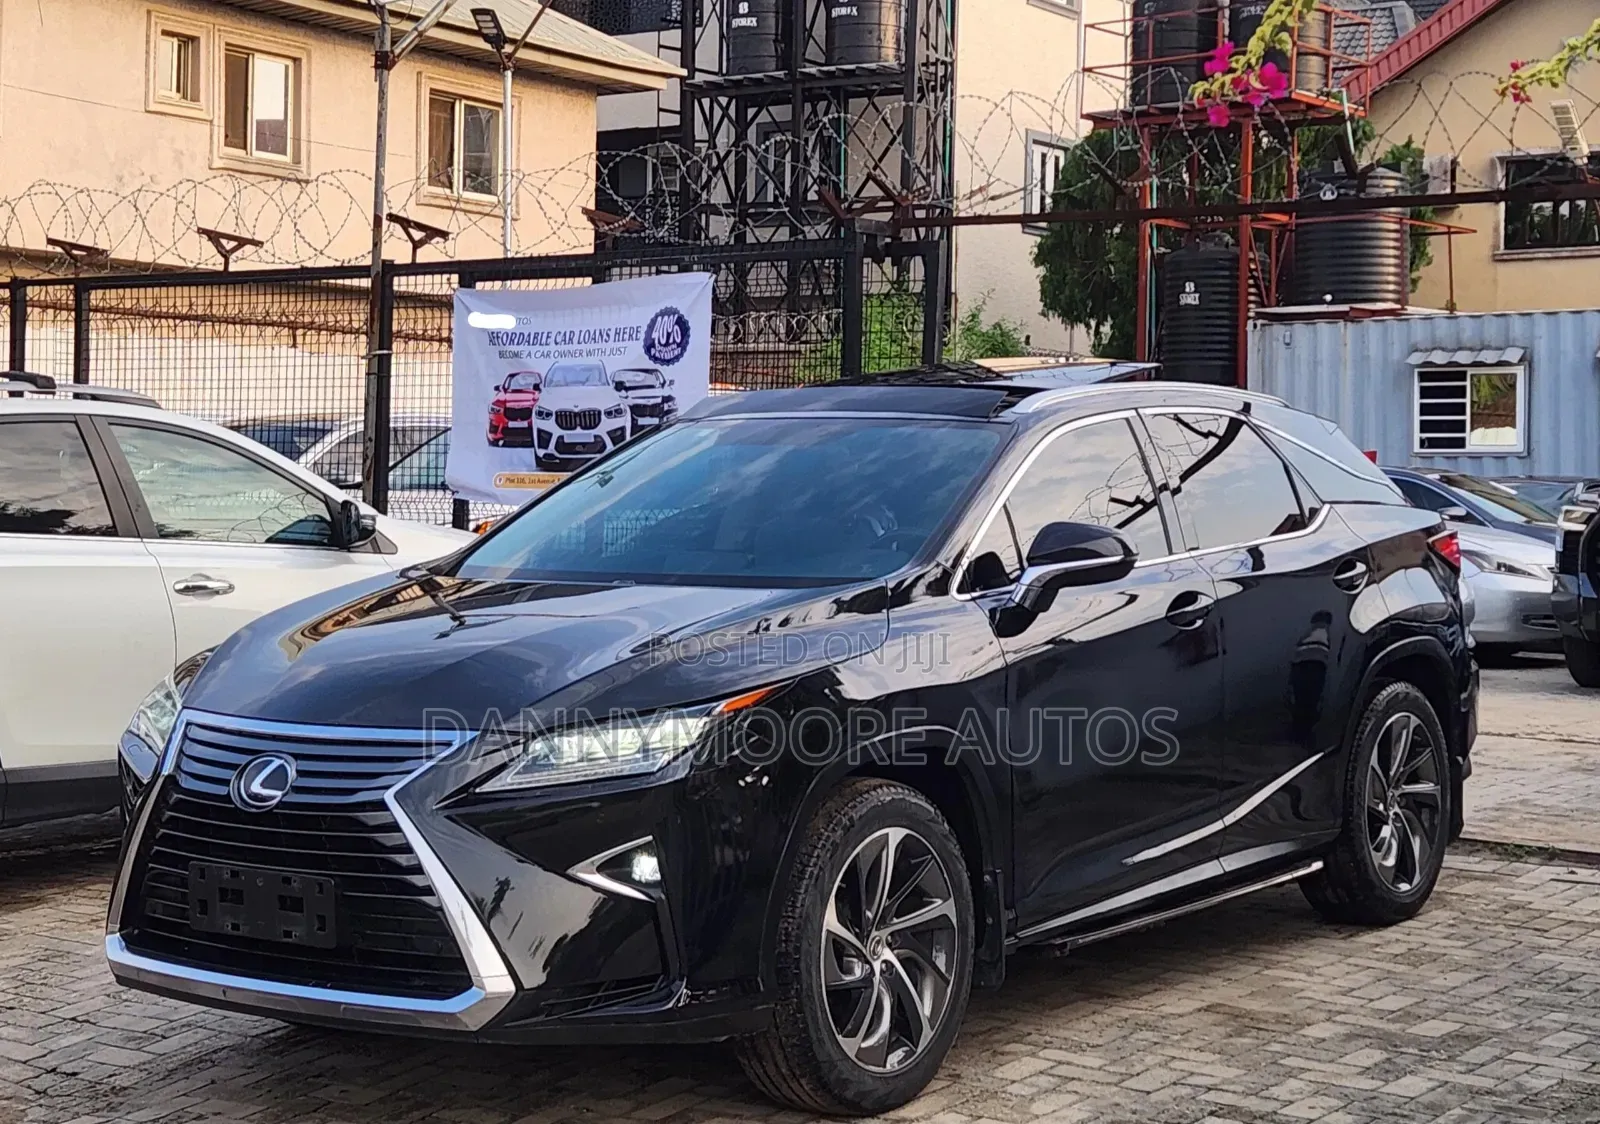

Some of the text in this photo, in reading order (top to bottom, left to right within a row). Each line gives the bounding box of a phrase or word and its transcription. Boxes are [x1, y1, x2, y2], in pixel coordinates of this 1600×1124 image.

[487, 325, 642, 347] AFFORDABLE CAR LOANS HERE
[651, 313, 682, 345] 40%
[498, 346, 628, 360] BECOME A CAR OWNER WITH JUST
